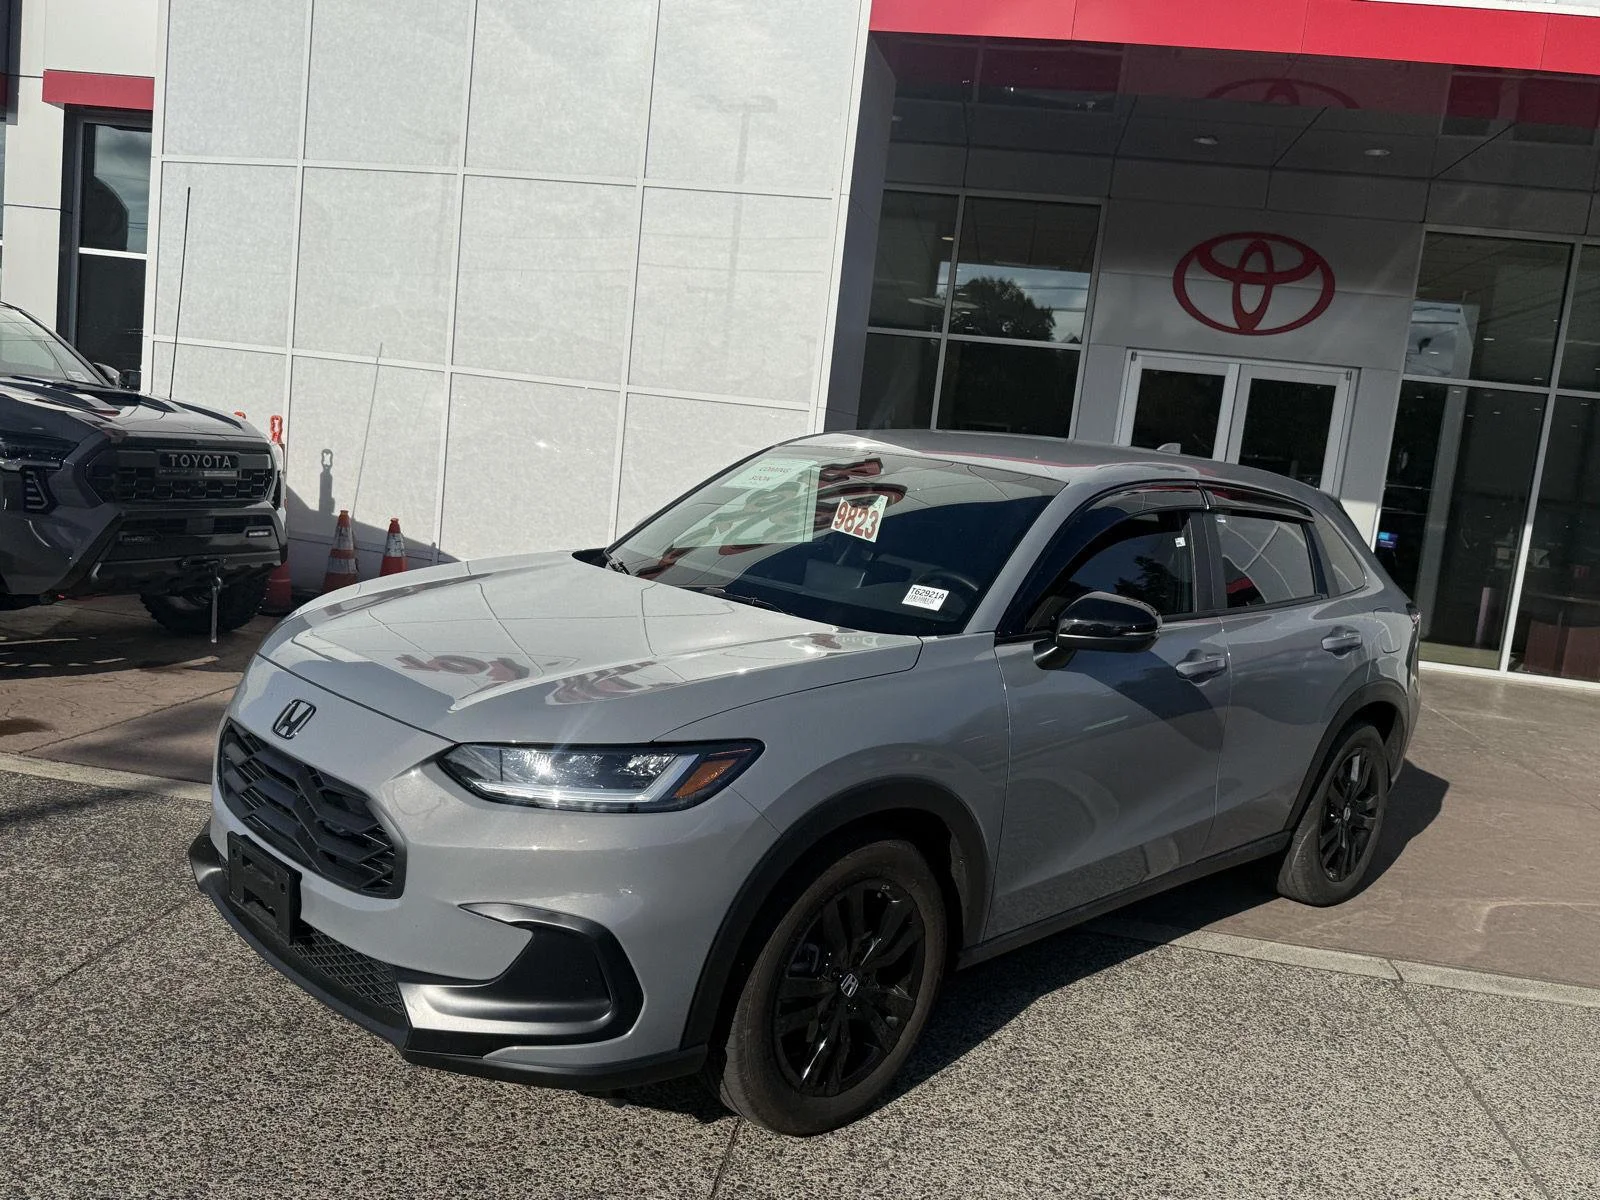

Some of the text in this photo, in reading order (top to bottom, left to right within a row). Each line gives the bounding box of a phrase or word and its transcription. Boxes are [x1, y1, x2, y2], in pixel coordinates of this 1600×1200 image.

[168, 453, 232, 469] TOYOTA
[834, 501, 879, 539] 9823
[910, 587, 946, 600] T62921A
